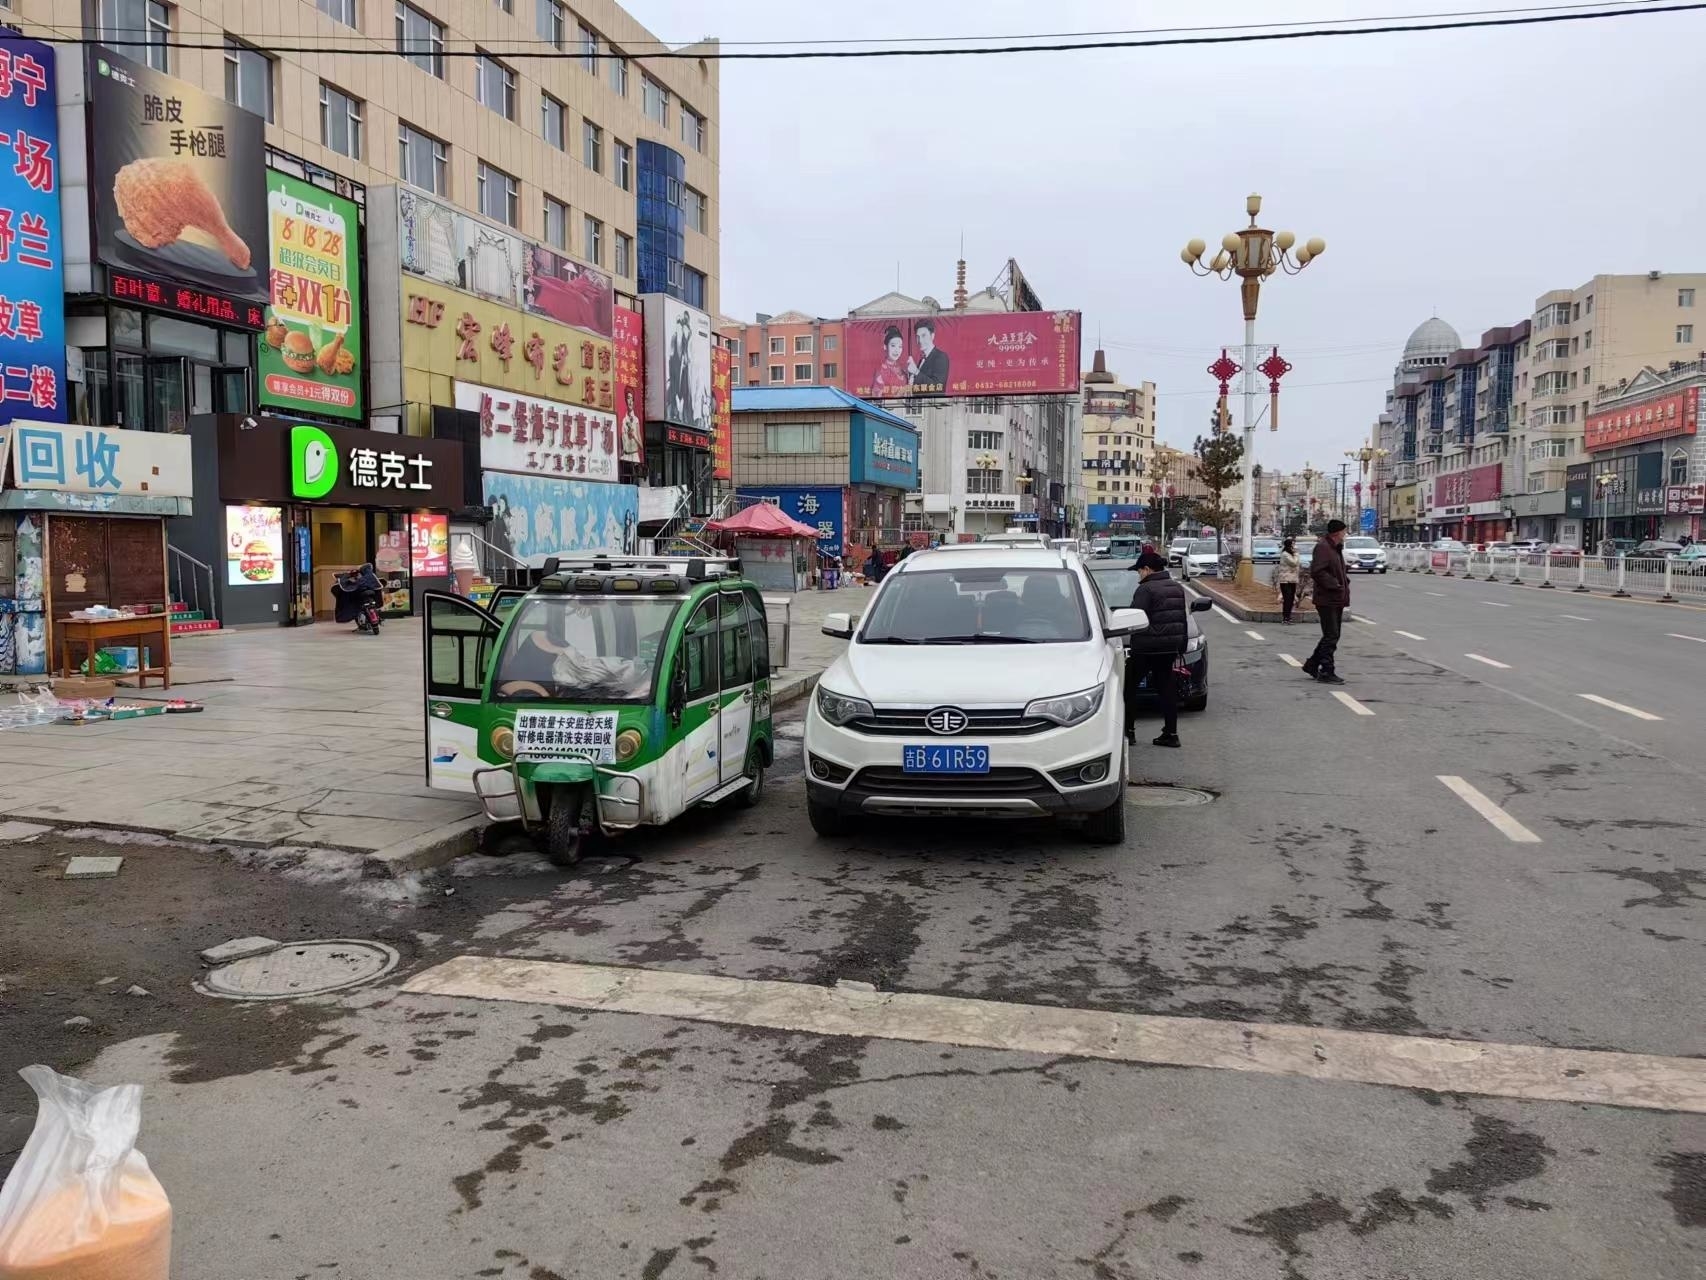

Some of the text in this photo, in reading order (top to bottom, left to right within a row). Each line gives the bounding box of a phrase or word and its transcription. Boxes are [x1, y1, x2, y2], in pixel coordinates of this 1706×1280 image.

[143, 94, 184, 124] 脆皮
[0, 130, 54, 193] 场
[169, 129, 227, 158] 手枪腿
[281, 217, 344, 257] 8 18 28
[279, 246, 342, 282] 超级会员日
[0, 363, 57, 410] 二楼
[18, 427, 122, 490] 回收
[349, 447, 433, 490] 德克士
[517, 730, 612, 745] 研修电器清洗安装回收
[519, 715, 614, 730] 出售流量卡安监控天线
